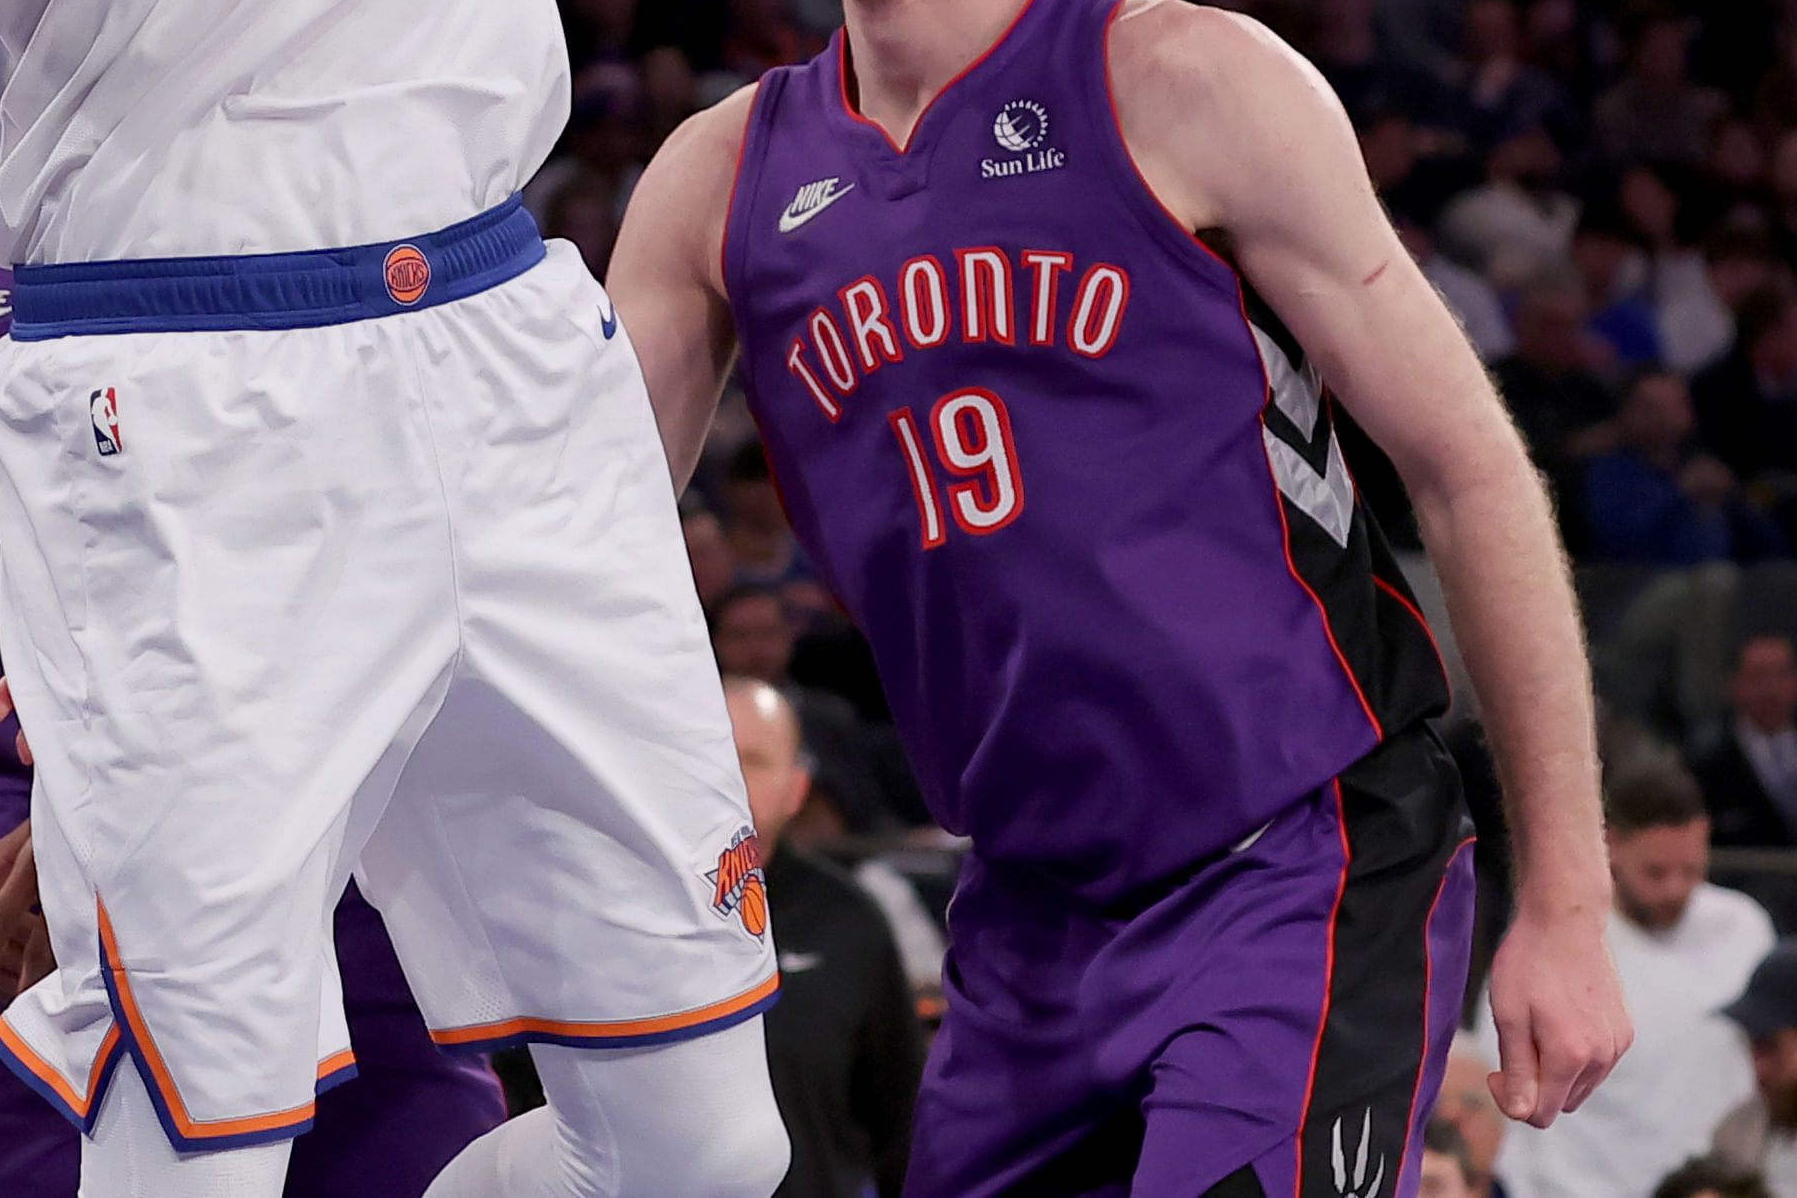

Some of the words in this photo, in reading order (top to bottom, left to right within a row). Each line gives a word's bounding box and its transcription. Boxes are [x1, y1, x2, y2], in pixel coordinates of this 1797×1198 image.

[790, 177, 841, 214] NIKE
[980, 158, 1024, 179] Sun
[1026, 147, 1065, 173] Life
[786, 245, 1132, 423] TORONTO
[887, 386, 1026, 551] 19
